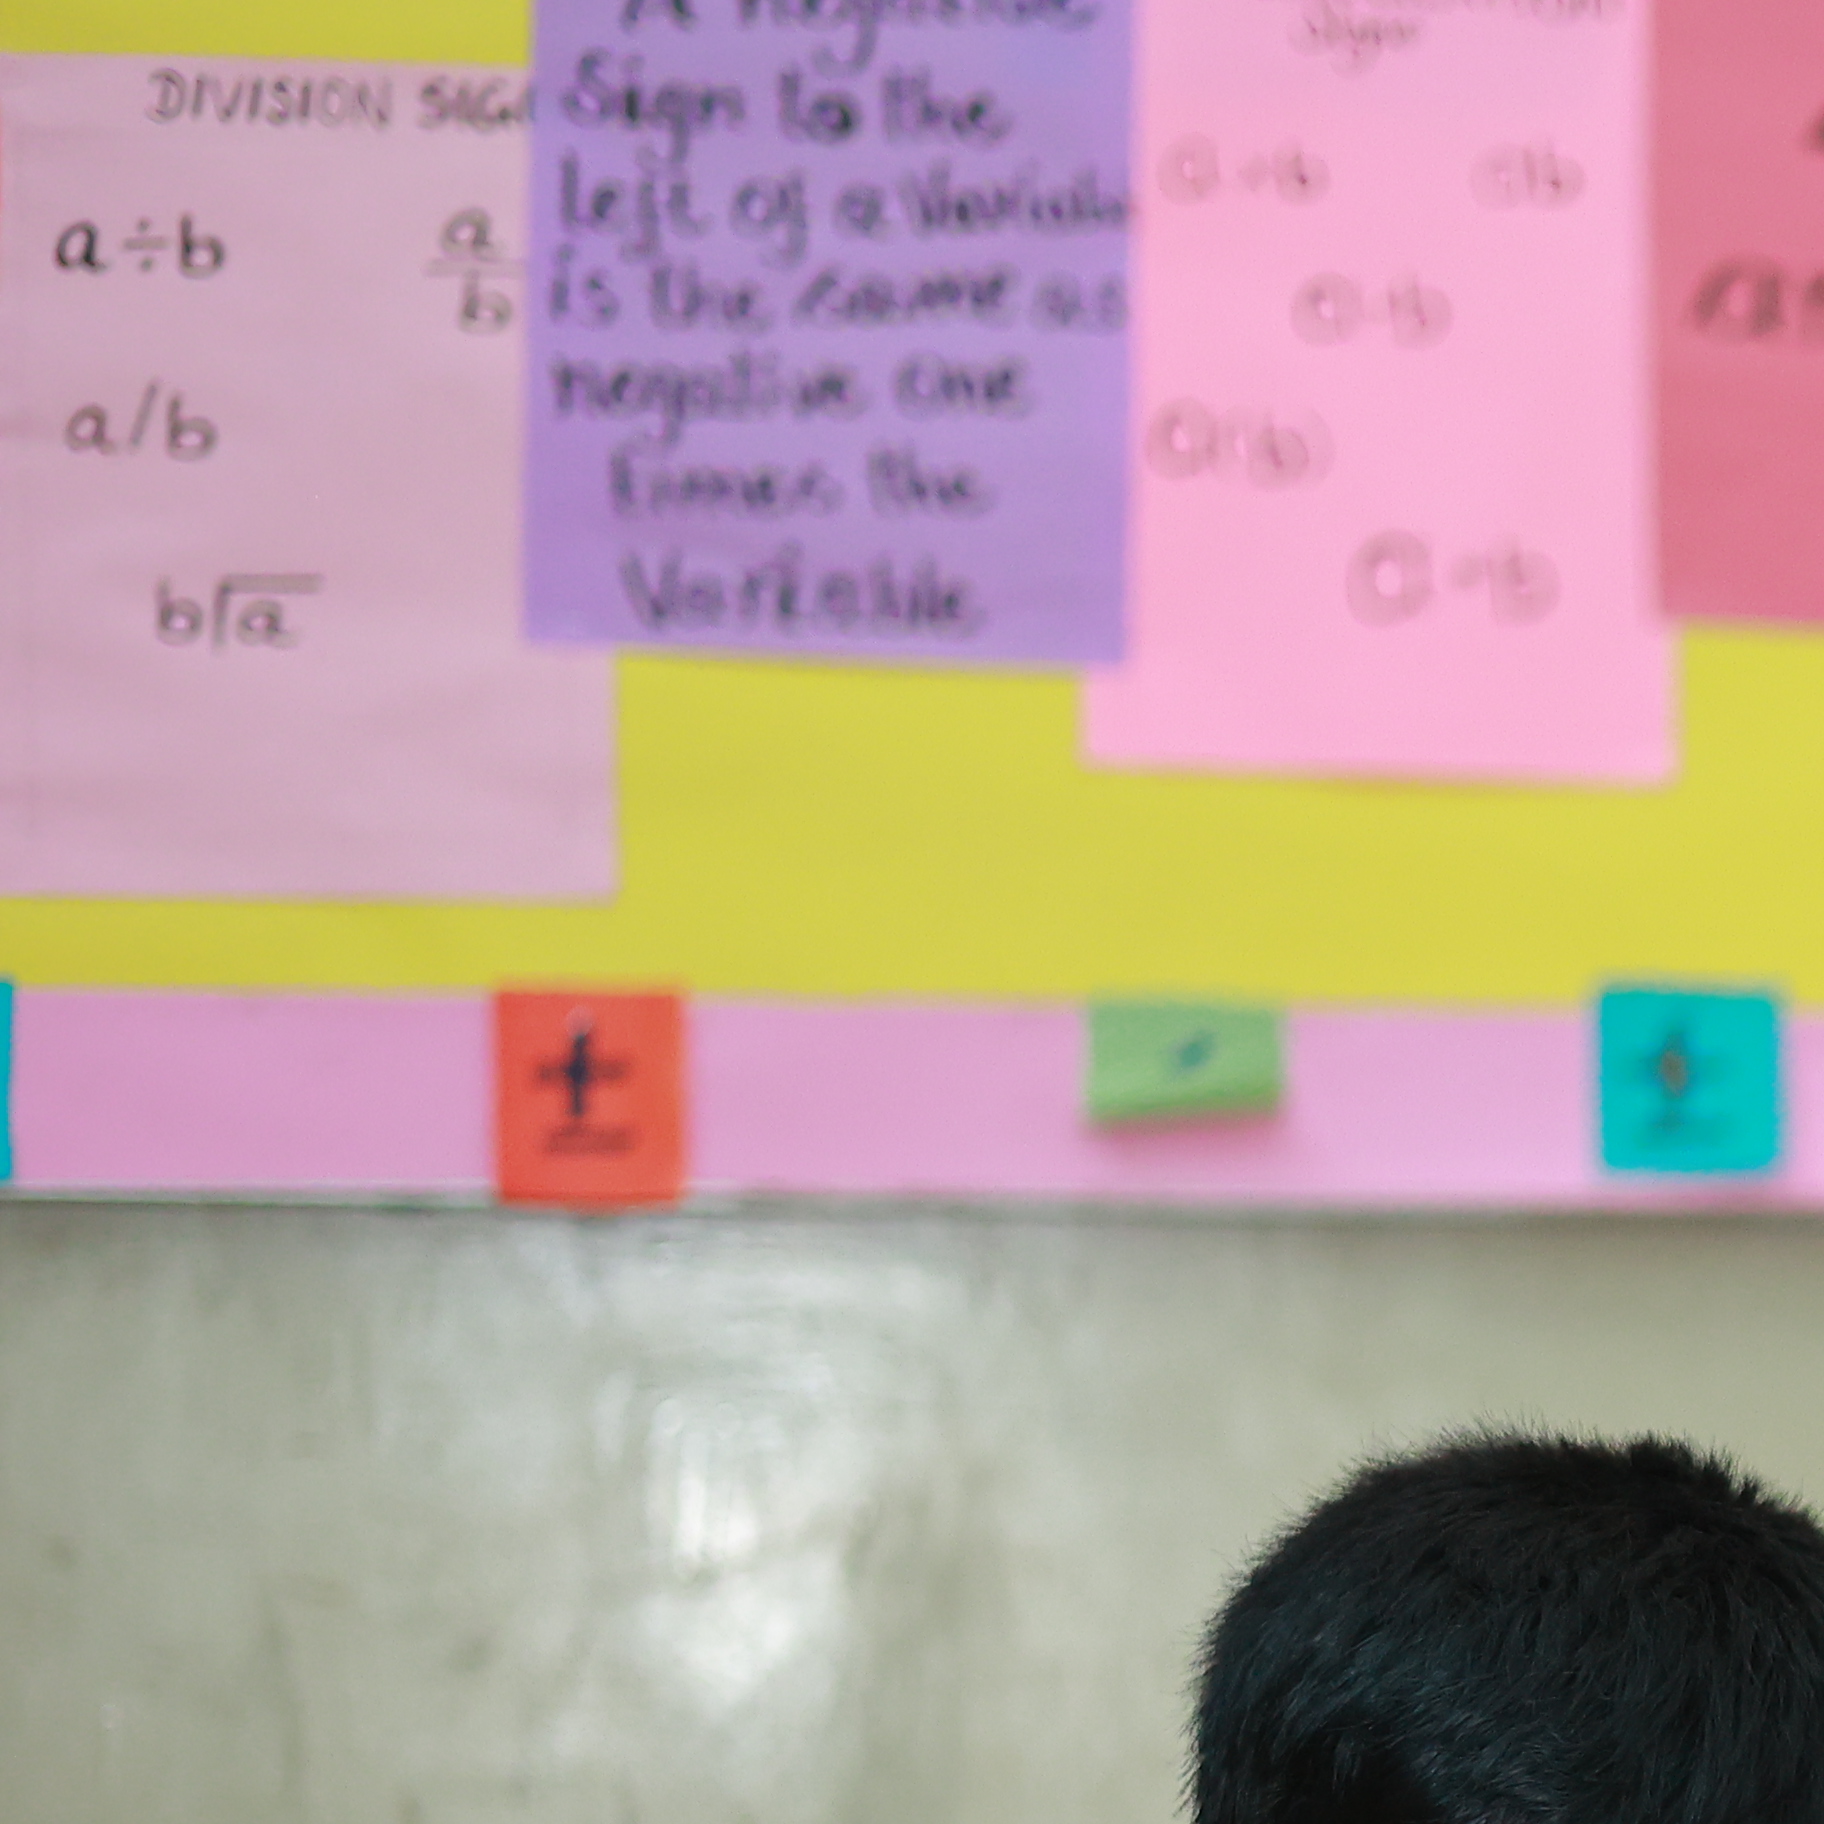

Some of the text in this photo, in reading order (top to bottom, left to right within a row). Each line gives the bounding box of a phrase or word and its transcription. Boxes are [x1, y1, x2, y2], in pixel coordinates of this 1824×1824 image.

[147, 66, 393, 132] DIVISION
[775, 66, 863, 145] to
[880, 65, 1013, 146] the
[558, 150, 710, 263] left
[728, 170, 809, 266] of
[833, 183, 890, 240] a
[548, 245, 619, 325] is
[650, 262, 776, 331] the
[548, 350, 872, 452] negative
[608, 440, 990, 518] times the
